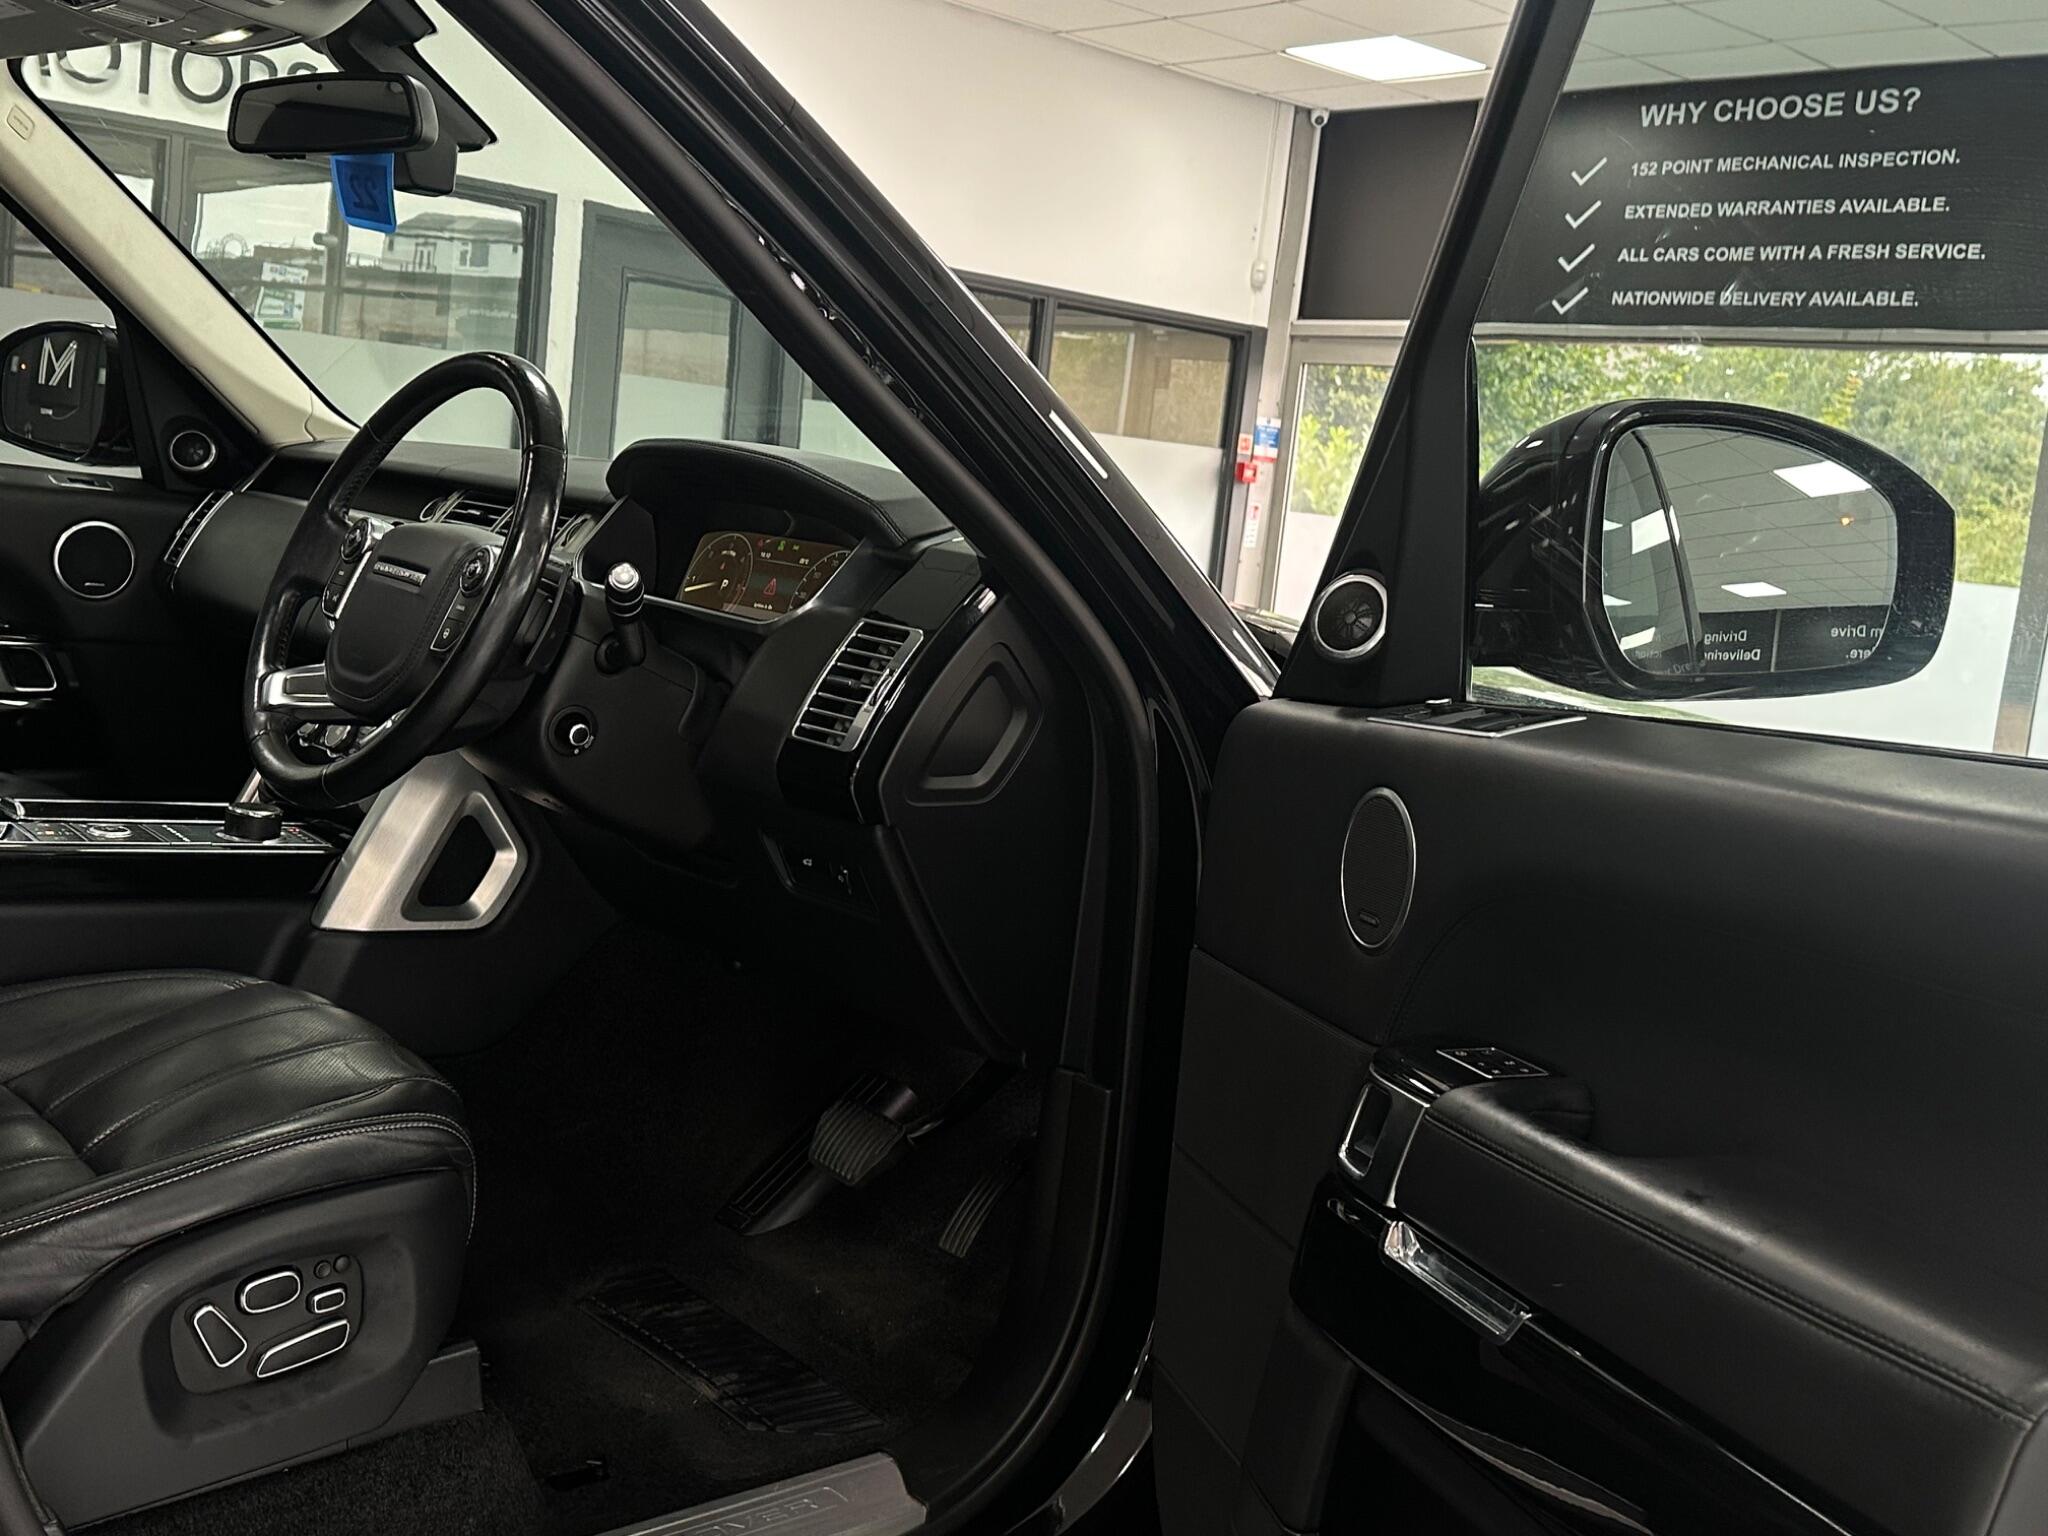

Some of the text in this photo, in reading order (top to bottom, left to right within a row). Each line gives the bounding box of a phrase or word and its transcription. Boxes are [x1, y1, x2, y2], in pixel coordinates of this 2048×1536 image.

[38, 41, 318, 104] OTO
[1640, 86, 1922, 128] WHY CHOOSE US?
[1631, 148, 1961, 177] 152 POINT MECHANICAL INSPECTION.
[1624, 196, 1950, 220] EXTENDED WARRANTIES AVAILABLE.
[1617, 243, 1986, 262] ALL CARS COME WITH A FRESH SERVICE.
[1611, 290, 1919, 308] NATIONWIDE DELIVERY AVAILABLE.
